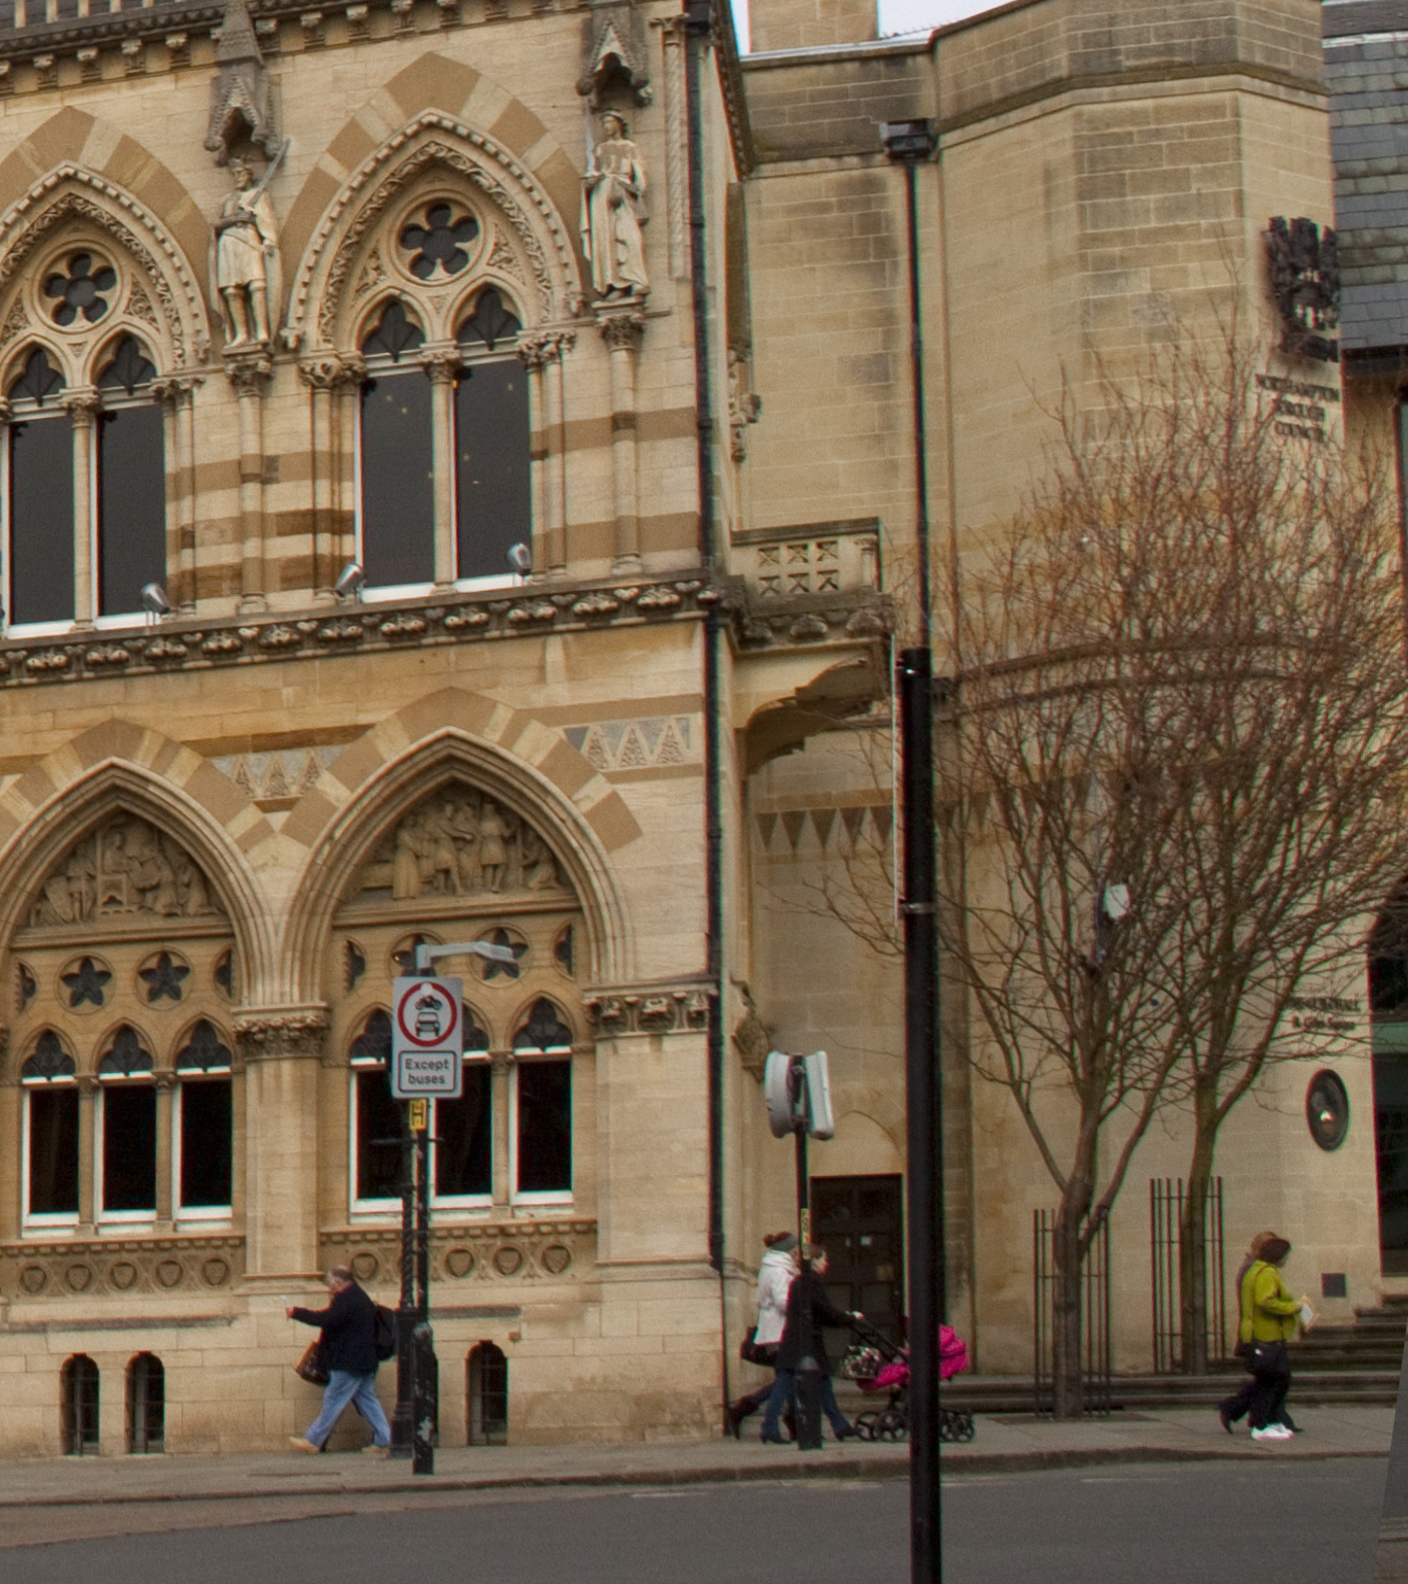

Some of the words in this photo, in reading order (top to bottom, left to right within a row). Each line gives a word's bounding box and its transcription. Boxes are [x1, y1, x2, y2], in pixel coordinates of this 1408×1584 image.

[405, 1058, 449, 1071] Except
[408, 1073, 445, 1084] buses
[411, 1102, 424, 1127] H
